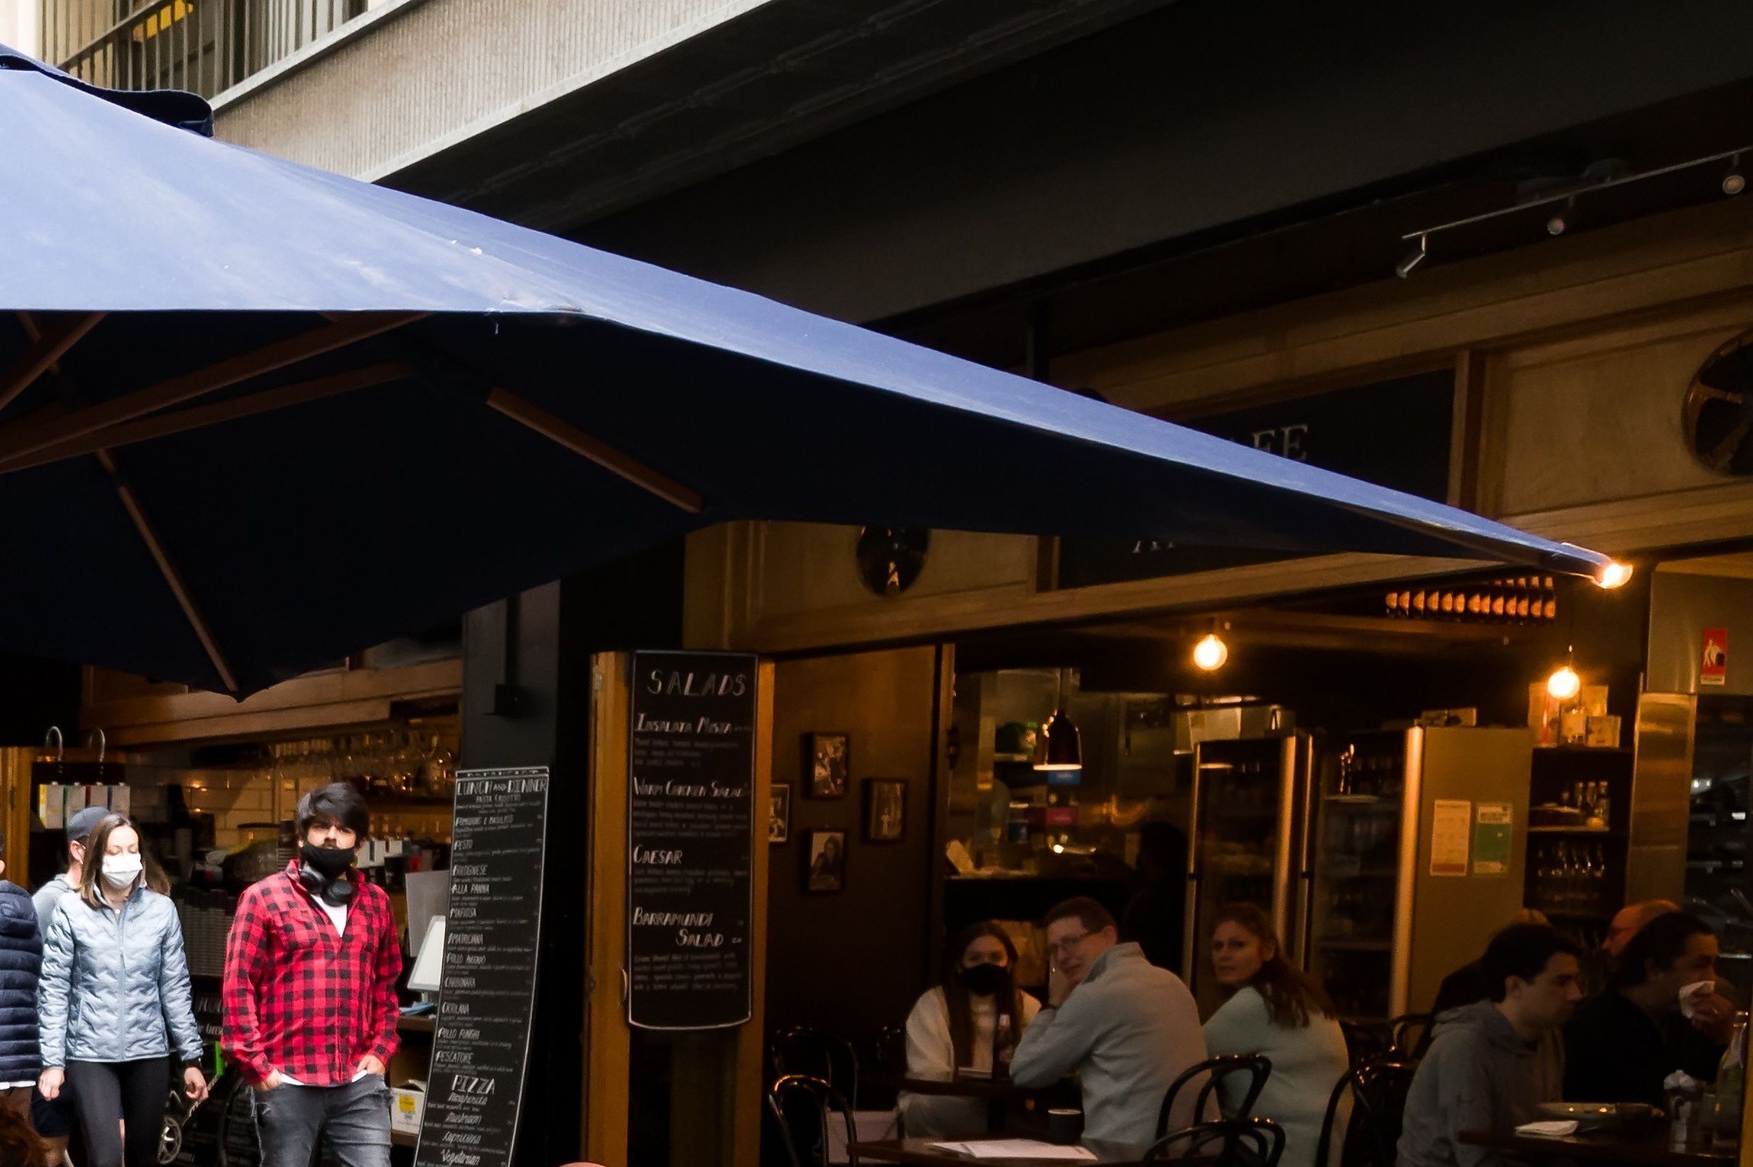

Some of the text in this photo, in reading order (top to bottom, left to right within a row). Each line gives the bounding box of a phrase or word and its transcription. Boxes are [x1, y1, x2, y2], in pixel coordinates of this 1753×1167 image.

[646, 669, 747, 697] SALADS
[457, 780, 493, 796] LUNCH
[507, 778, 548, 794] DINNER
[633, 843, 683, 865] CAESAR
[633, 906, 714, 927] BARRAMUNDI
[676, 928, 724, 947] SALAD
[451, 1074, 496, 1095] PIZZA
